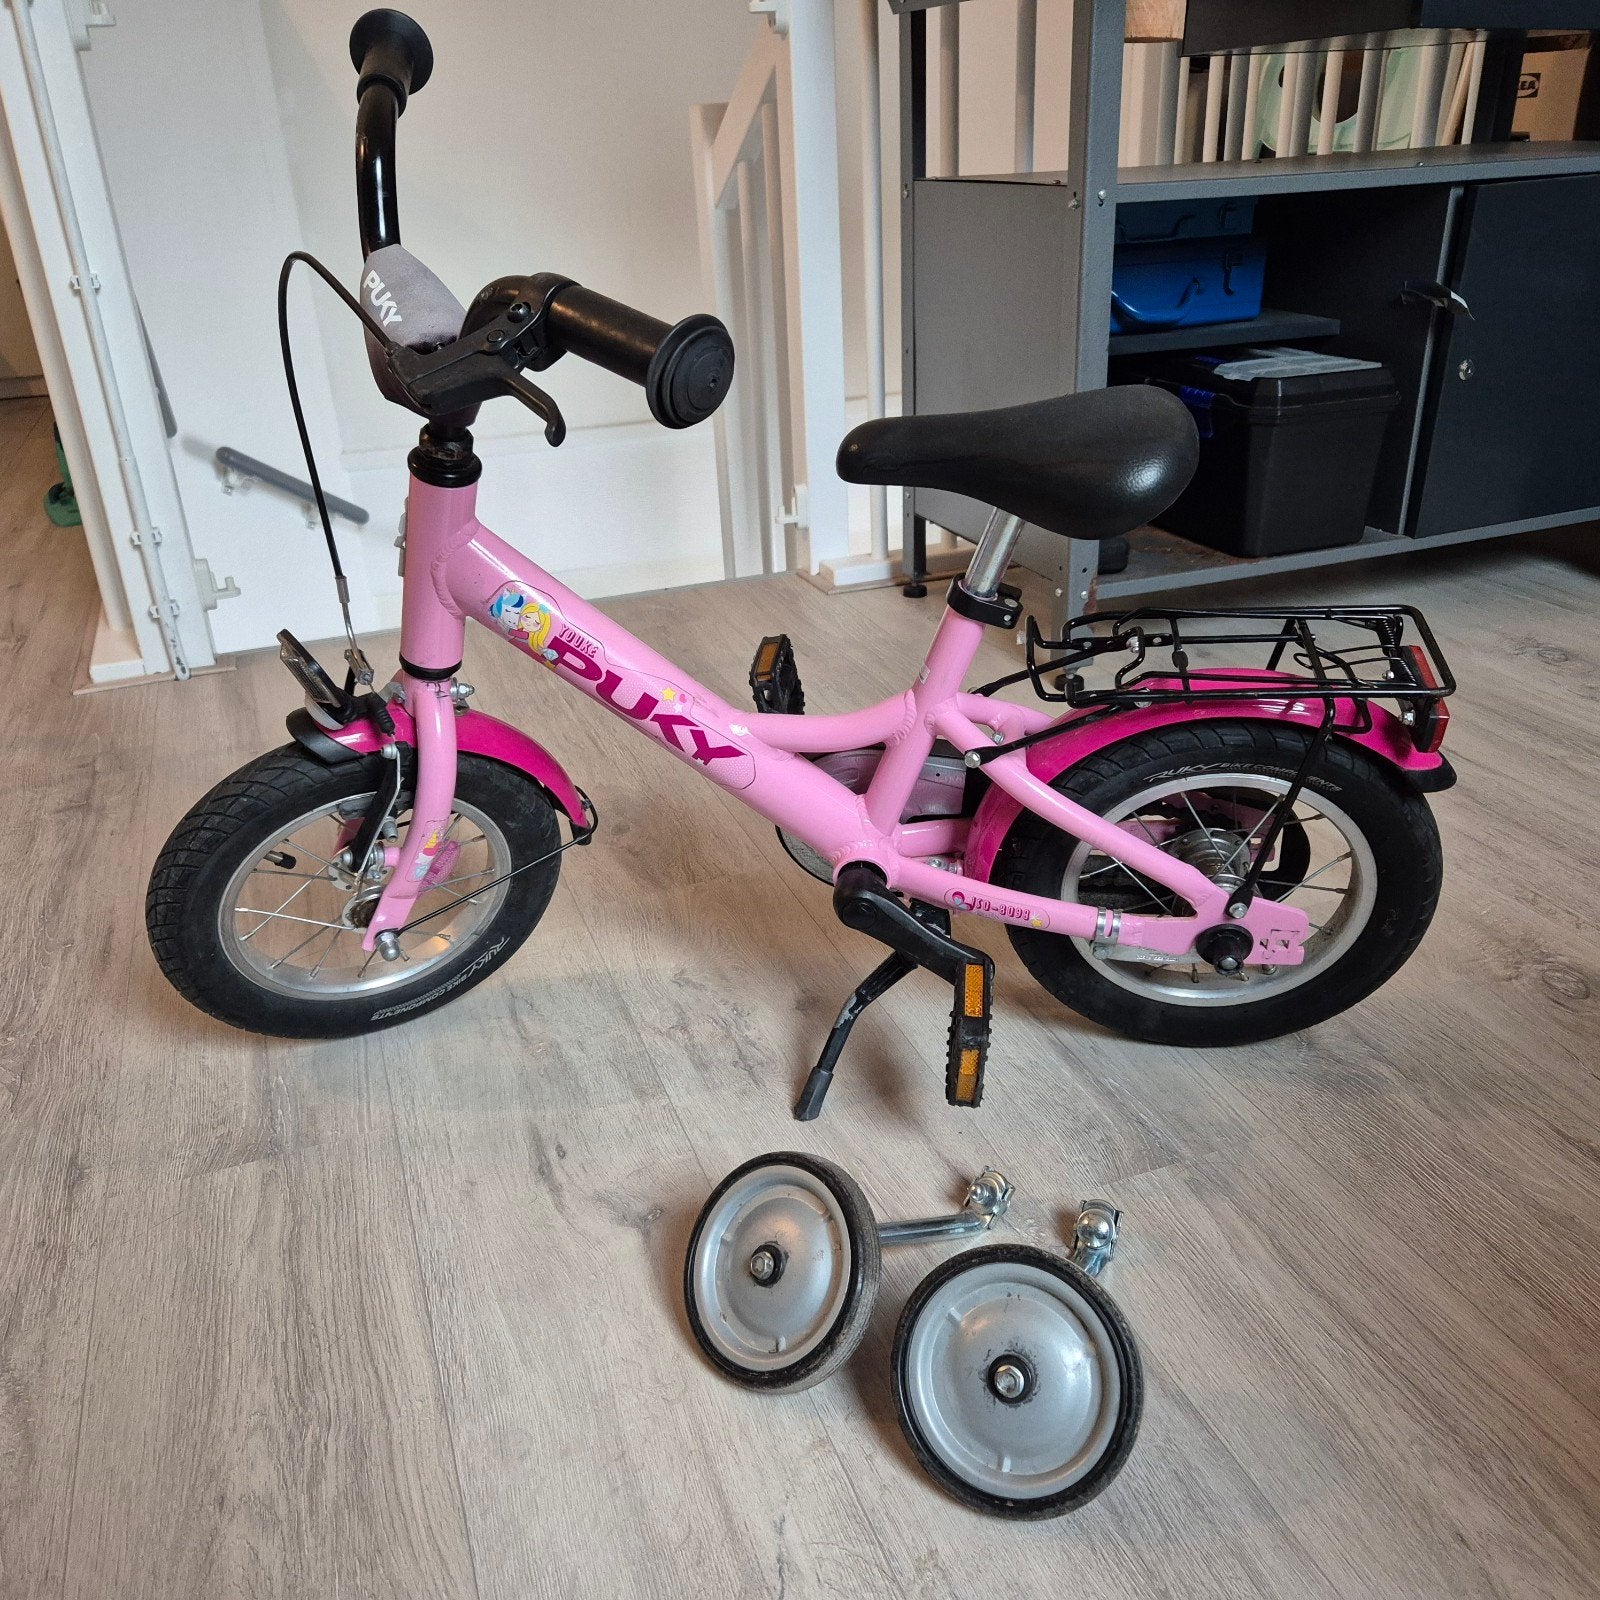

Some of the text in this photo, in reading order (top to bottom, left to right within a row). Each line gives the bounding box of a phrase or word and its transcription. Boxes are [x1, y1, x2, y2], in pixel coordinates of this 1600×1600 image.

[1518, 80, 1536, 91] EA
[363, 269, 403, 327] PUKY
[559, 623, 599, 659] YOUKE
[547, 635, 747, 766] PUKY
[971, 896, 1030, 921] ISO-8098
[446, 974, 467, 992] BIKE
[371, 988, 446, 1020] COMPONENTS
